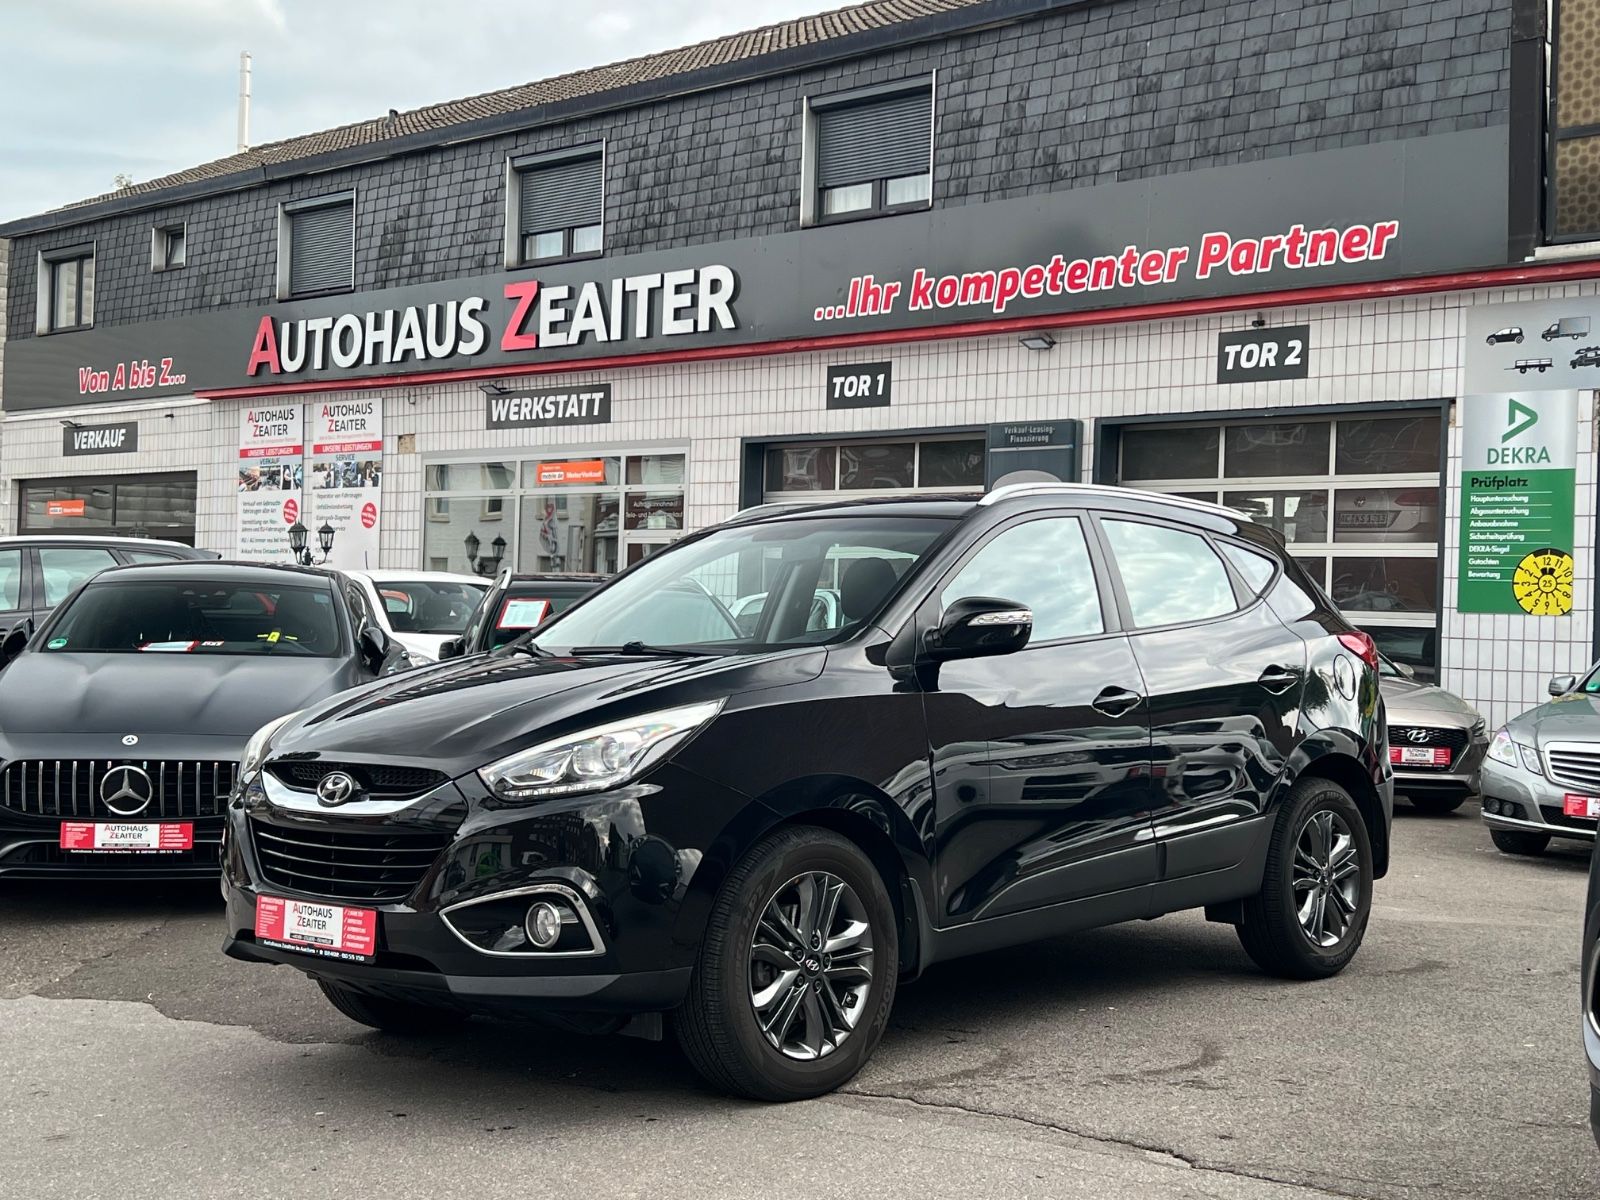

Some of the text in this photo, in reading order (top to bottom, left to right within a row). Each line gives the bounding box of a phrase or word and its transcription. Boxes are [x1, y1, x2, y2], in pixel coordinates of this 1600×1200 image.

[909, 245, 1189, 313] kompetenter
[1195, 219, 1399, 280] Partner
[246, 264, 736, 376] AUTOHAUS ZEAITER
[1223, 339, 1302, 371] TOR 2
[79, 367, 109, 394] Von
[112, 363, 125, 391] A
[129, 360, 156, 389] bis
[832, 373, 885, 399] TOR 1
[322, 403, 373, 418] AUTOHAUS
[490, 391, 604, 422] WERKSTATT
[248, 408, 294, 424] AUTOHAUS
[253, 424, 288, 437] ZEAITER
[328, 419, 366, 432] ZEAITER
[73, 429, 126, 450] VERKAUF
[1010, 435, 1049, 443] Finanzierung
[336, 453, 355, 461] SERVICE
[1487, 446, 1551, 465] DEKRA
[1471, 475, 1528, 490] Prüfplatz
[1470, 494, 1529, 503] Hauptuntersuchung
[1468, 558, 1499, 566] Gutachten
[1542, 557, 1551, 566] 12
[1468, 571, 1500, 580] Bewertung
[1542, 580, 1552, 588] 25
[104, 824, 148, 832] AUTOHAUS
[292, 902, 333, 919] AUTOHAUS
[297, 915, 327, 930] ZEAITER
